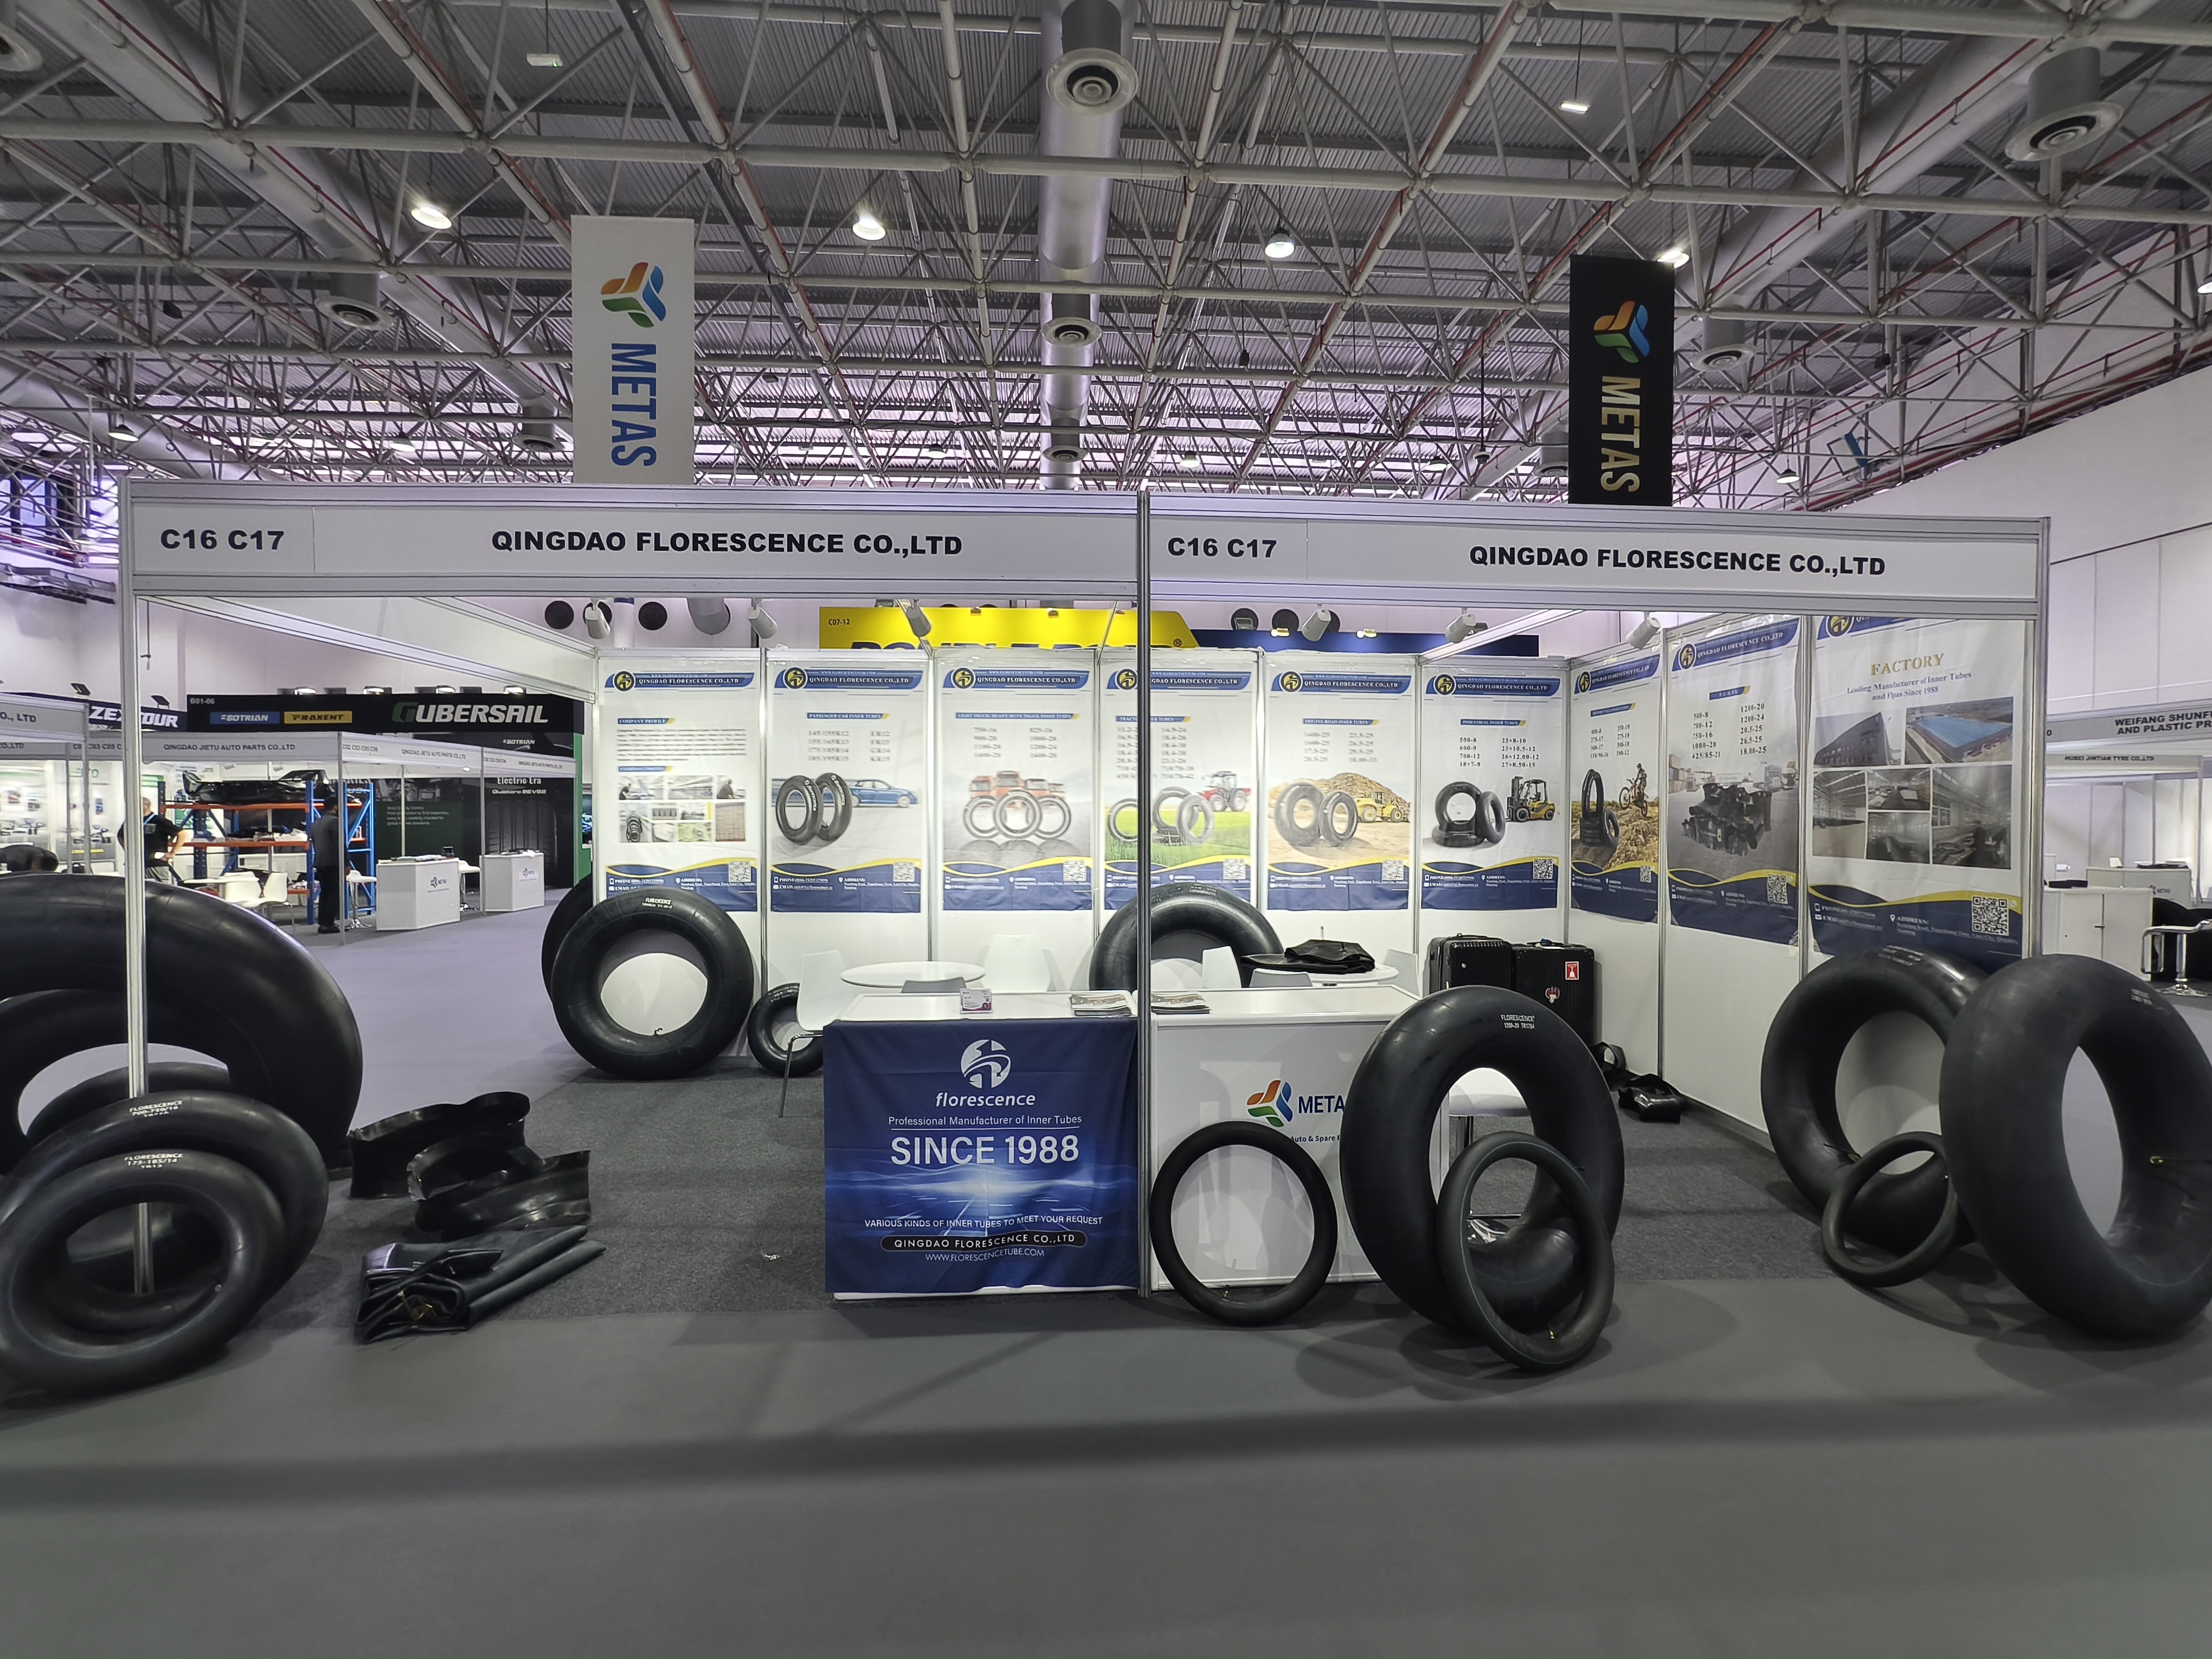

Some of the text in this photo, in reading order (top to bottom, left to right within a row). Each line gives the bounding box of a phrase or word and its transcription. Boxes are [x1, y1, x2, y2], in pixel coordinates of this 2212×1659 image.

[611, 343, 657, 466] METAS
[1601, 376, 1641, 492] METAS
[161, 529, 284, 550] C16 C17
[492, 531, 962, 558] QINGDAO FLORESCENCE CO.,LTD
[1168, 538, 1277, 557] C16 C17
[1470, 546, 1885, 577] QINGDAO FLORESCENCE CO.,LTD
[1870, 653, 1944, 676] FACTORY
[1928, 675, 1947, 683] Inner
[1950, 672, 1971, 681] Tubes
[1924, 686, 1939, 694] 1988
[392, 702, 549, 723] GUBERSAIL
[1741, 703, 1765, 712] 1200-20
[17, 714, 36, 723] LTD
[89, 706, 178, 728] ZEOUR
[1741, 714, 1764, 723] 1200-24
[2115, 710, 2212, 726] WEIFANG SHUNF
[2117, 726, 2140, 734] AND
[2144, 722, 2192, 732] PLASTIC
[936, 1092, 1036, 1107] florescence
[1298, 1095, 1345, 1113] META
[889, 1115, 1082, 1126] Professional Manufacturer of Inner Tubes
[891, 1135, 1079, 1165] SINCE 1988
[864, 1219, 902, 1228] VARIOUS
[904, 1219, 930, 1227] KINDS
[946, 1219, 973, 1227] INNER
[975, 1219, 1001, 1228] TUBES
[1003, 1218, 1014, 1226] TO
[1017, 1215, 1038, 1225] MEET
[1040, 1215, 1064, 1224] YOUR
[1066, 1215, 1103, 1225] REQUEST
[894, 1233, 1075, 1248] QINGDAO FLORESCENCE CO.,LTD
[925, 1248, 1045, 1262] WWW.FLORESCENCETUBE.COM
